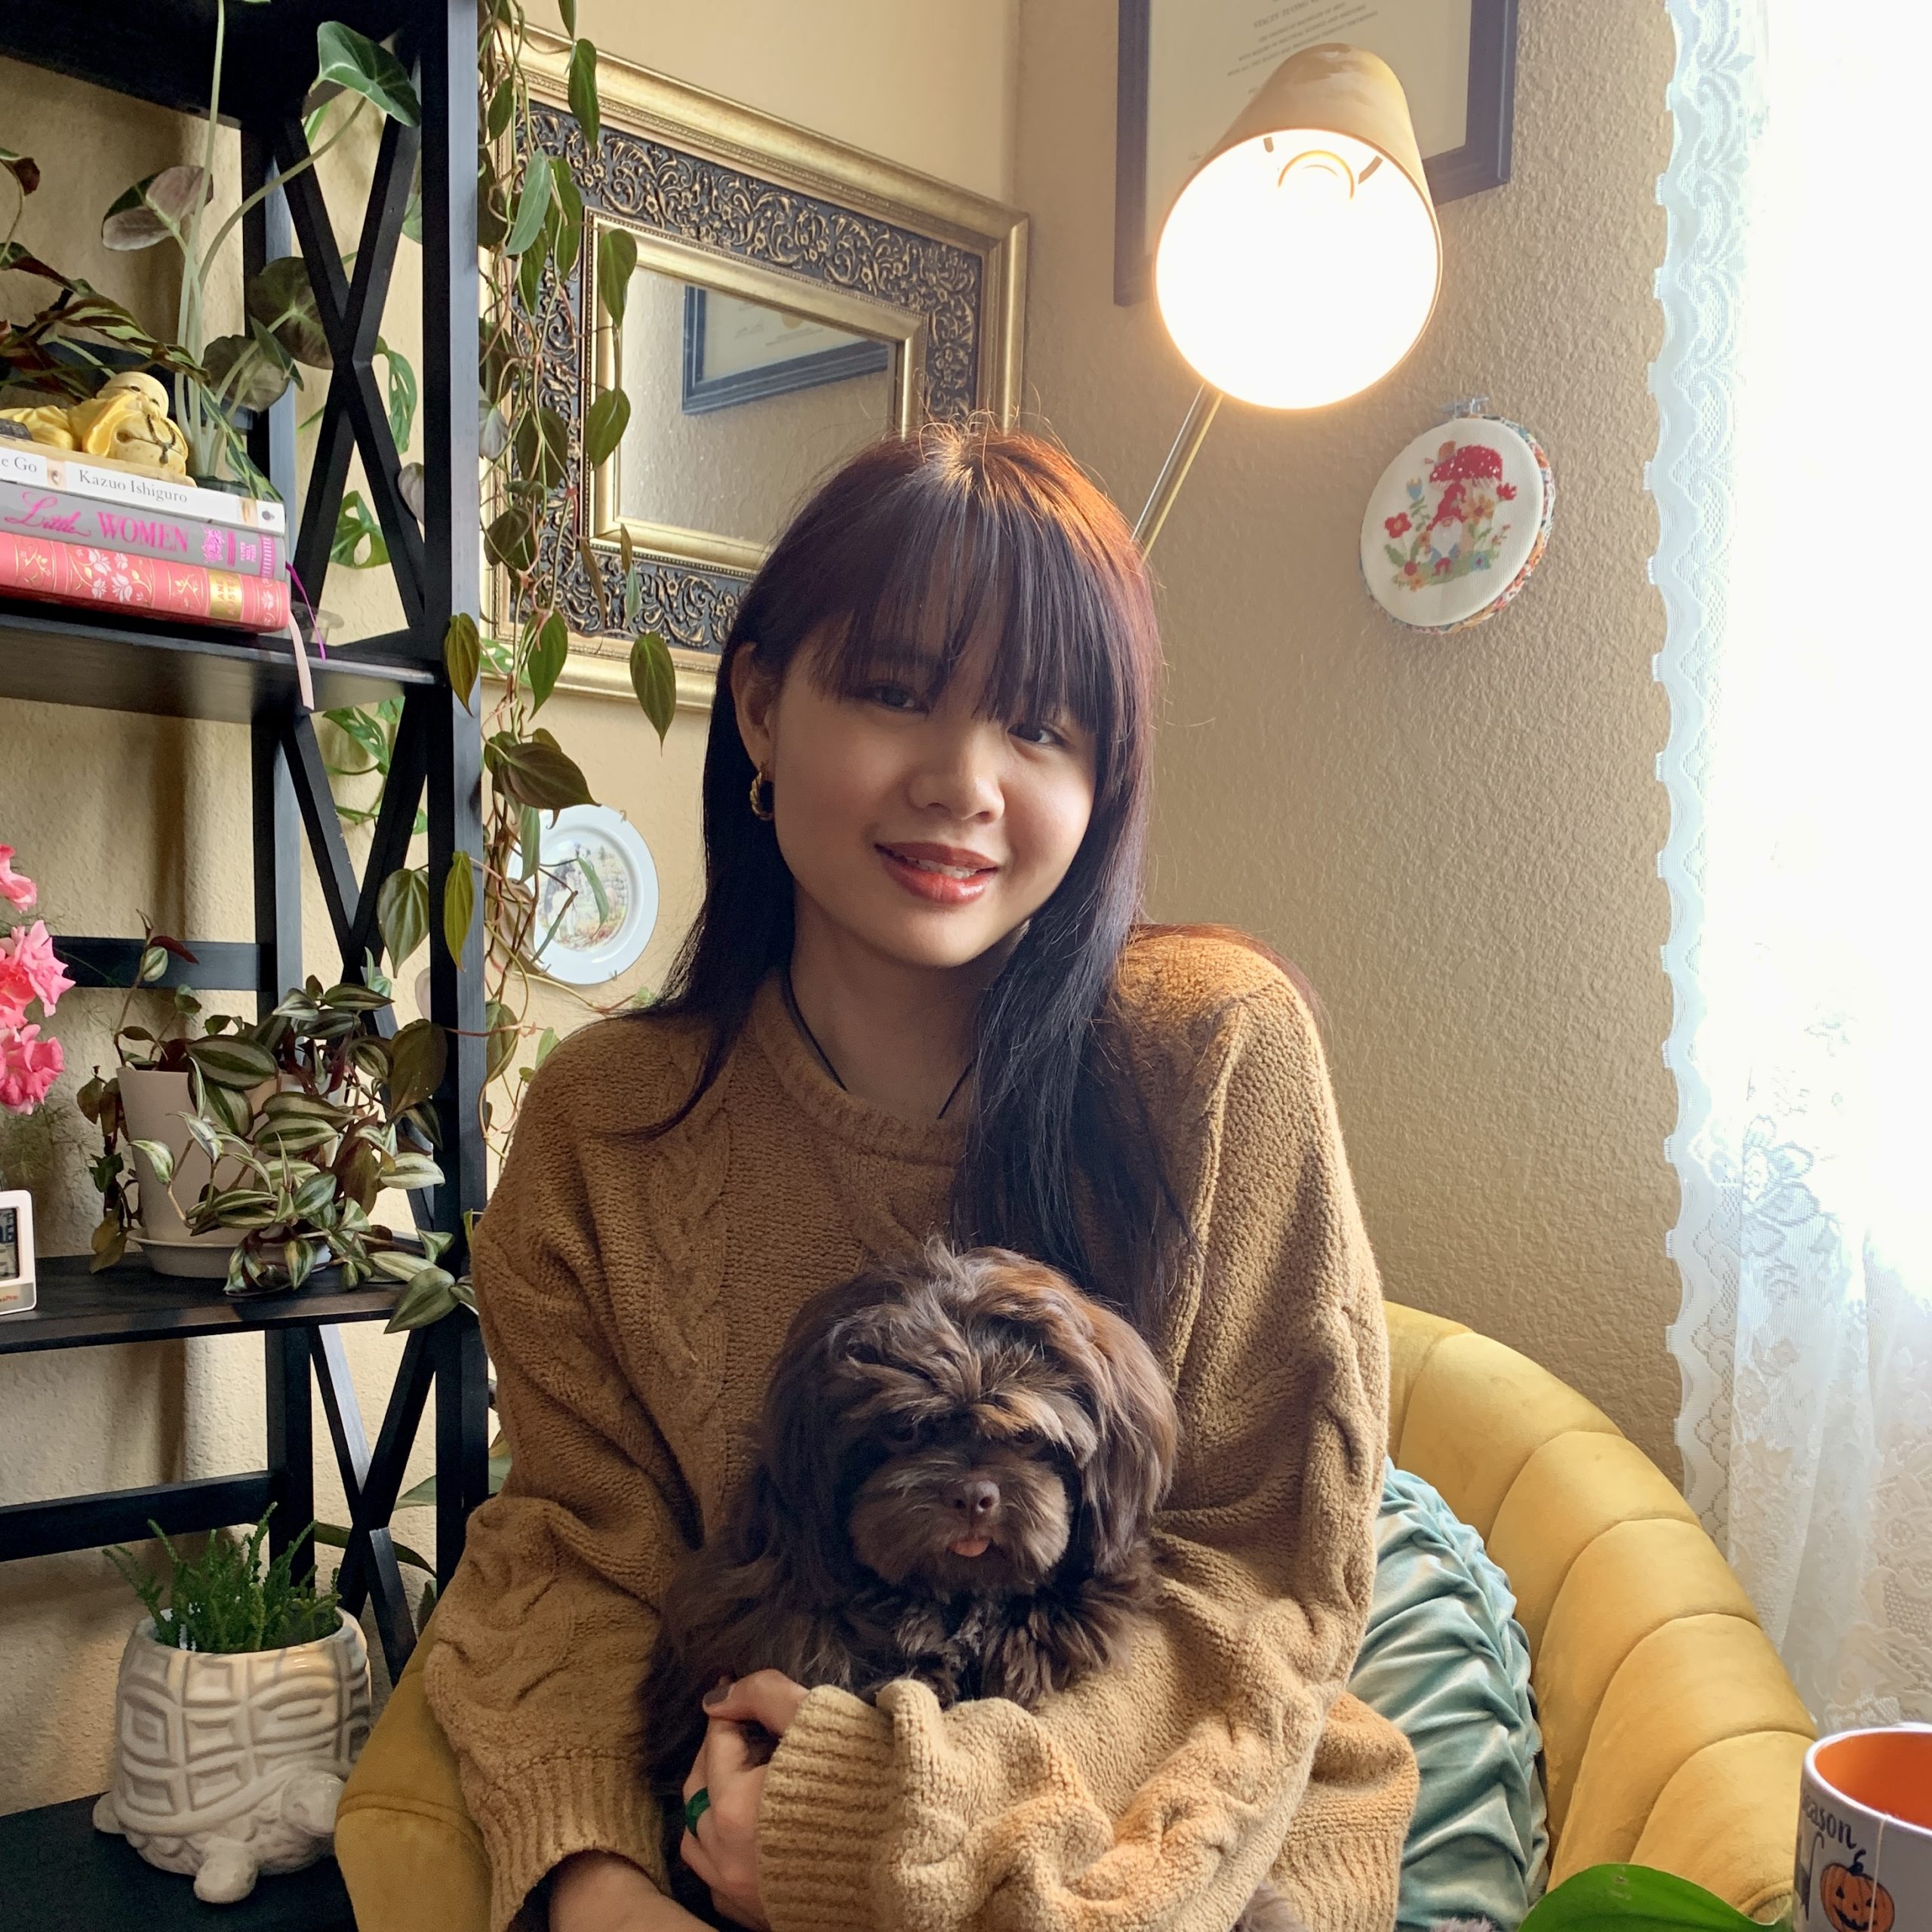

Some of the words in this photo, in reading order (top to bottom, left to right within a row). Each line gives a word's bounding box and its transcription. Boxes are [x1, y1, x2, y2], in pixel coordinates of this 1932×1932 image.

[14, 457, 37, 472] Go
[78, 469, 126, 491] Kazuo
[131, 480, 188, 503] Ishiguro
[4, 491, 91, 537] Little
[97, 511, 187, 553] WOMEN
